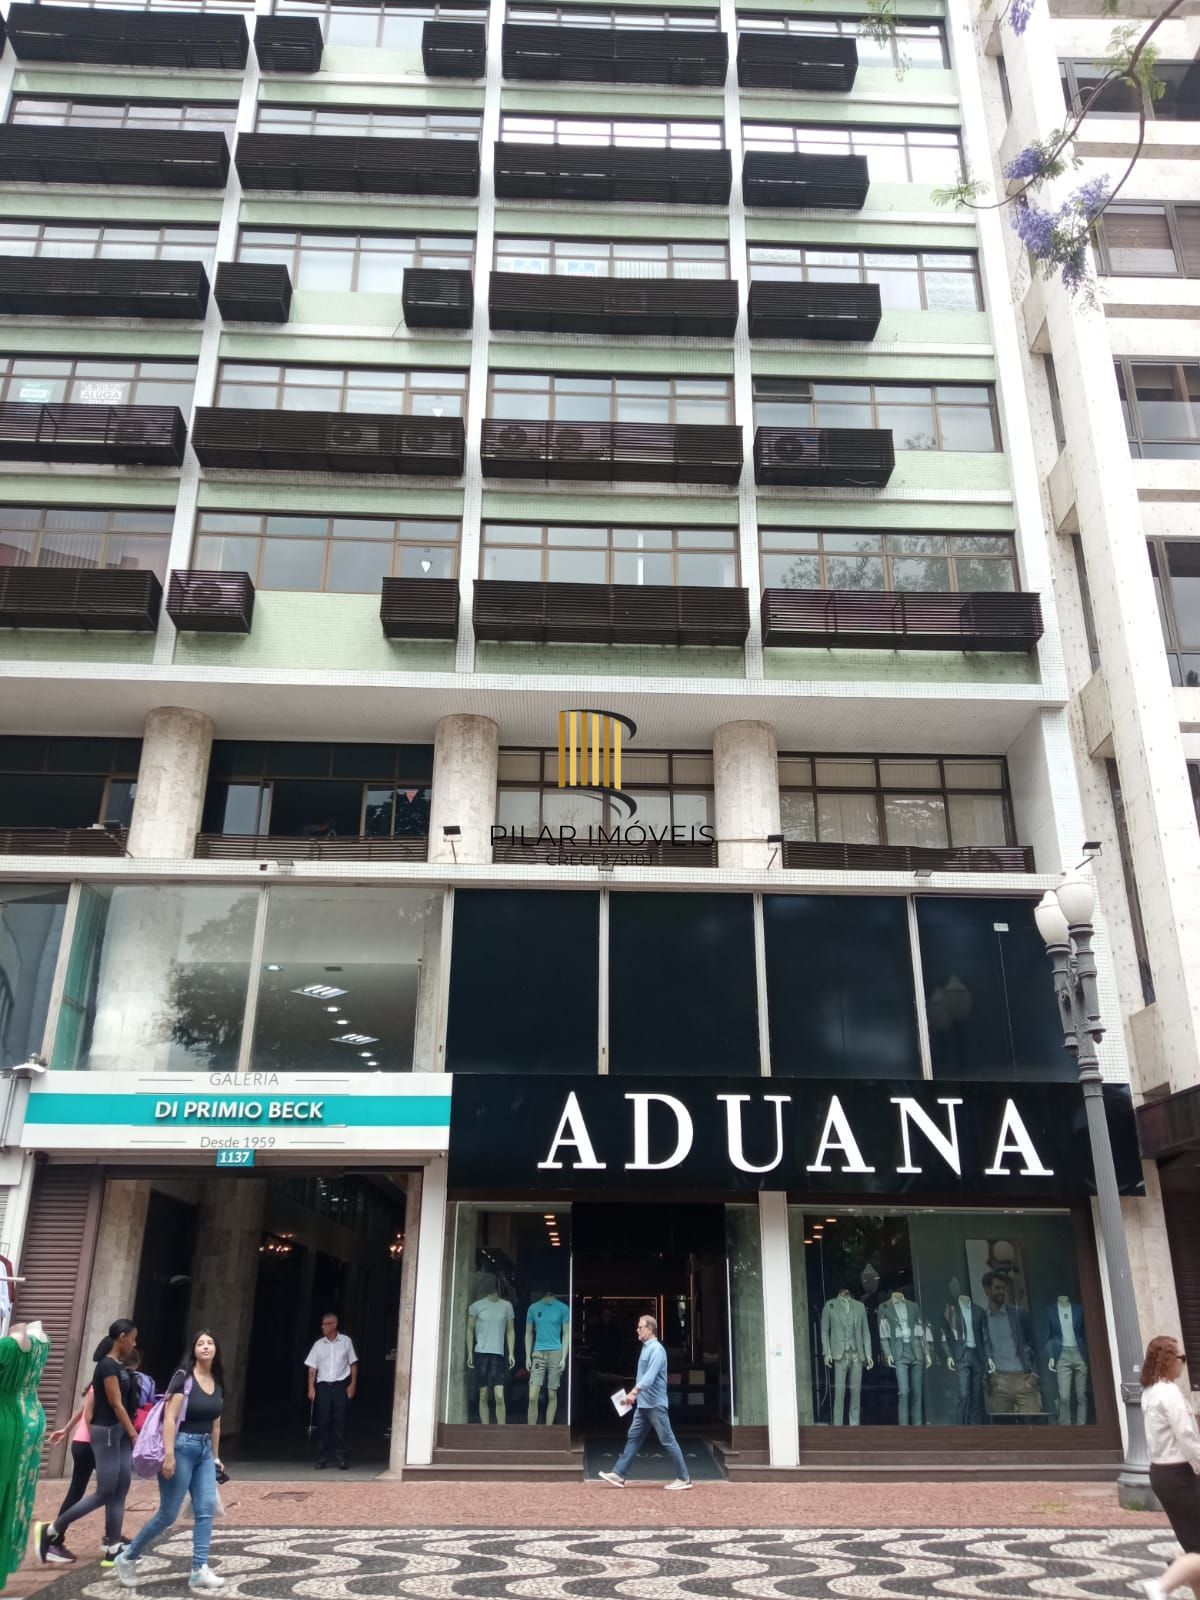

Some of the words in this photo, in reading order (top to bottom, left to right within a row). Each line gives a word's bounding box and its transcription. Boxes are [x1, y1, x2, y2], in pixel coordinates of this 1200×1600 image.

[82, 391, 120, 399] ALUGA
[209, 1072, 279, 1086] GALERIA
[155, 1101, 178, 1119] DI
[184, 1101, 262, 1120] PRIMIO
[268, 1101, 324, 1119] BECK
[537, 1090, 1055, 1177] ADUANA
[200, 1136, 240, 1148] Desde
[244, 1137, 276, 1148] 1959
[219, 1151, 250, 1164] 1137
